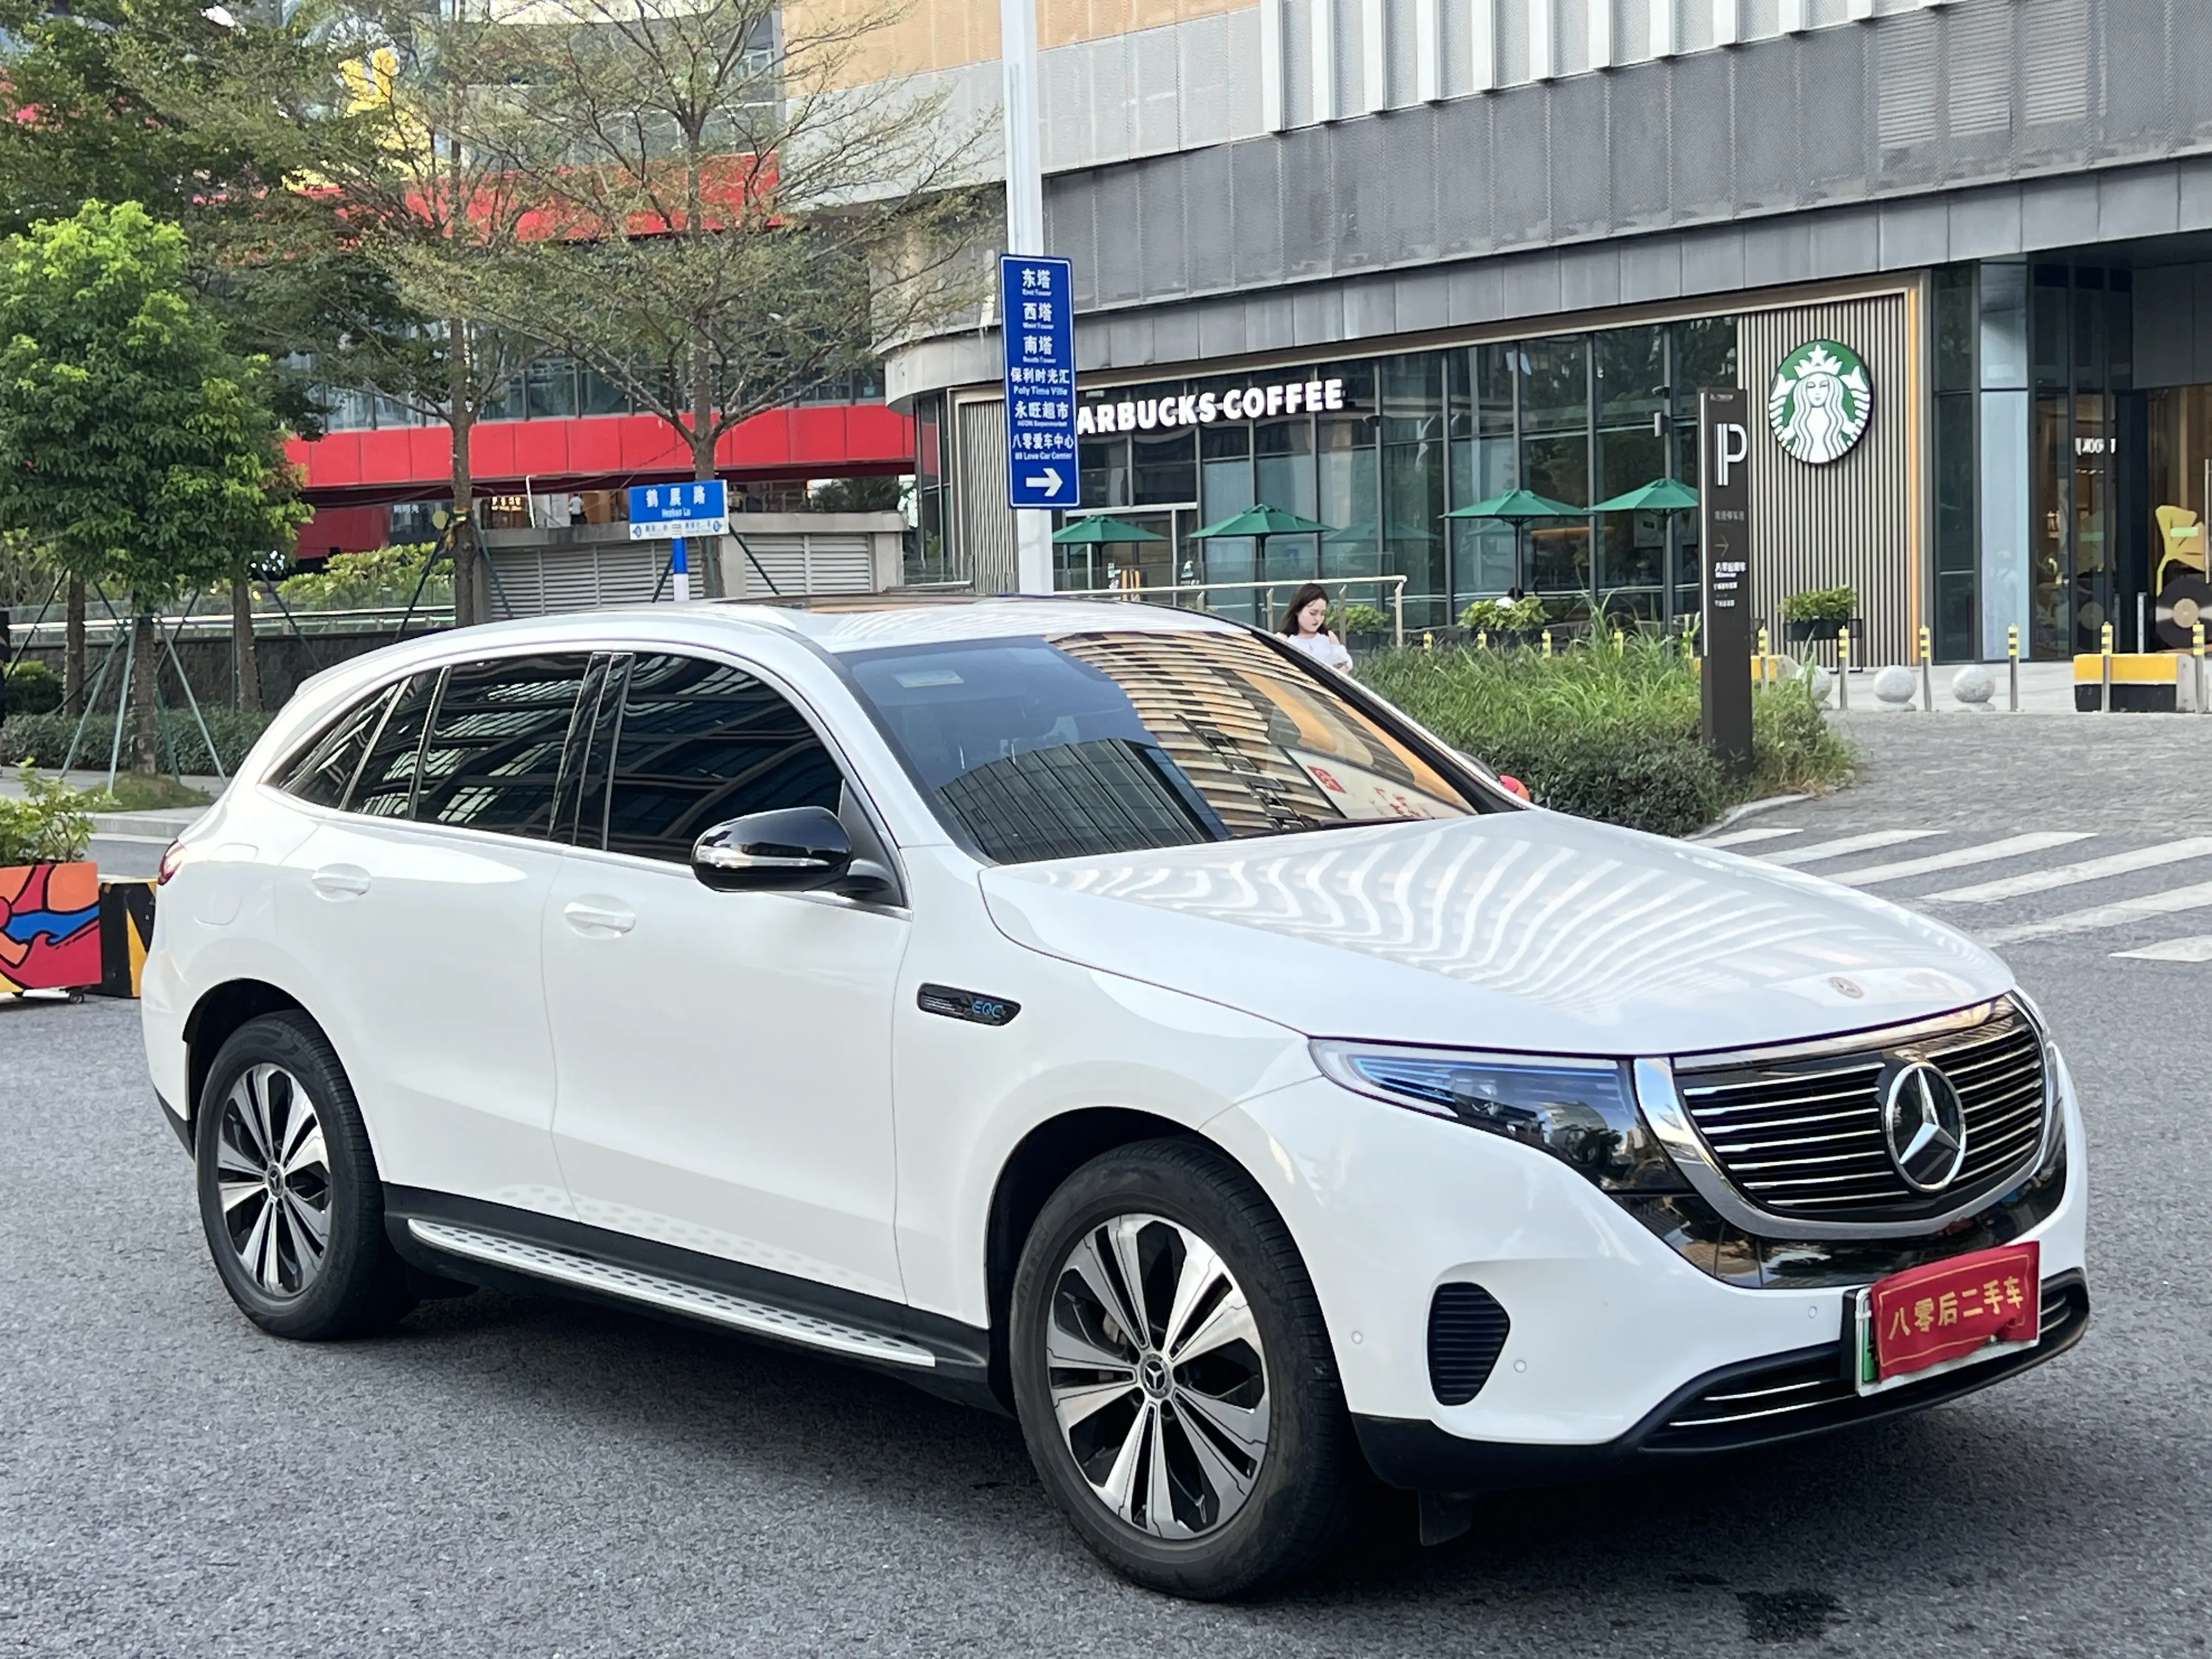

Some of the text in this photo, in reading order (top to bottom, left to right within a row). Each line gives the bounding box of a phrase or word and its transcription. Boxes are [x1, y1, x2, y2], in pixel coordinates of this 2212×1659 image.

[1022, 268, 1051, 289] 东塔
[1023, 302, 1052, 322] 西塔
[1023, 335, 1053, 355] 南塔
[1011, 367, 1070, 384] 保利时光汇
[1013, 385, 1030, 396] Poly
[1031, 386, 1049, 395] Time
[1015, 400, 1069, 420] 永旺超市
[1077, 379, 1343, 435] ARBUCKS COFFEE
[1012, 432, 1074, 450] 八零爱车中心
[1714, 424, 1747, 487] P
[972, 1000, 1003, 1019] EQC
[1889, 1276, 2024, 1341] 八零后二手车
